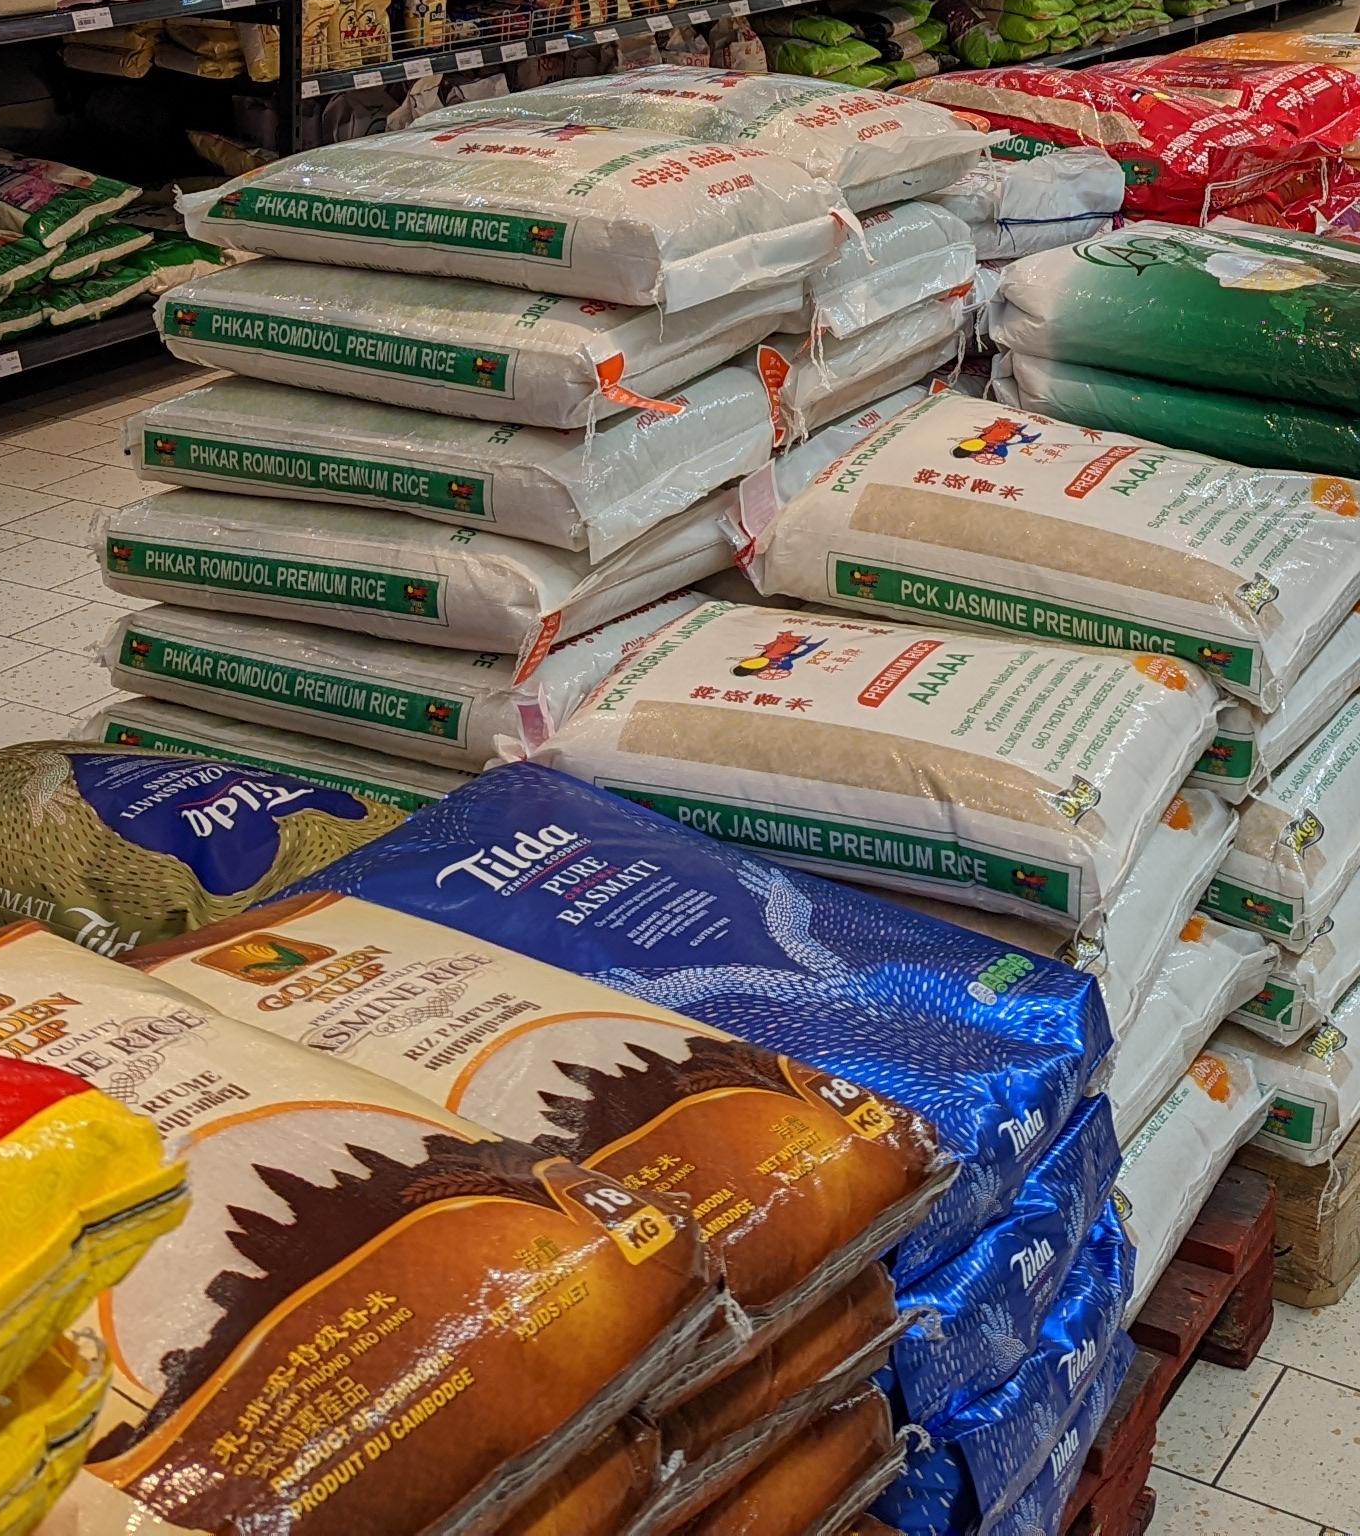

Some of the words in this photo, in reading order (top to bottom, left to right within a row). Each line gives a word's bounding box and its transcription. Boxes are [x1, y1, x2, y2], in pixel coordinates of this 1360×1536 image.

[255, 195, 309, 222] PHKAR
[311, 200, 390, 230] ROMDUOL
[395, 211, 468, 238] PREMIUM
[471, 218, 509, 243] RICE
[435, 823, 579, 892] Tilda
[500, 865, 544, 897] GENUINE
[544, 837, 593, 866] GOODNESS
[677, 806, 724, 838] PCK
[728, 814, 823, 854] JASMINE
[828, 829, 934, 871] PREMIUM
[938, 852, 988, 884] RICE
[540, 856, 609, 896] PURE
[556, 859, 662, 926] BASMATI
[257, 944, 394, 1014] GOLDEN
[303, 963, 388, 1005] TULIP
[820, 1078, 861, 1108] 18
[852, 1107, 885, 1134] KG
